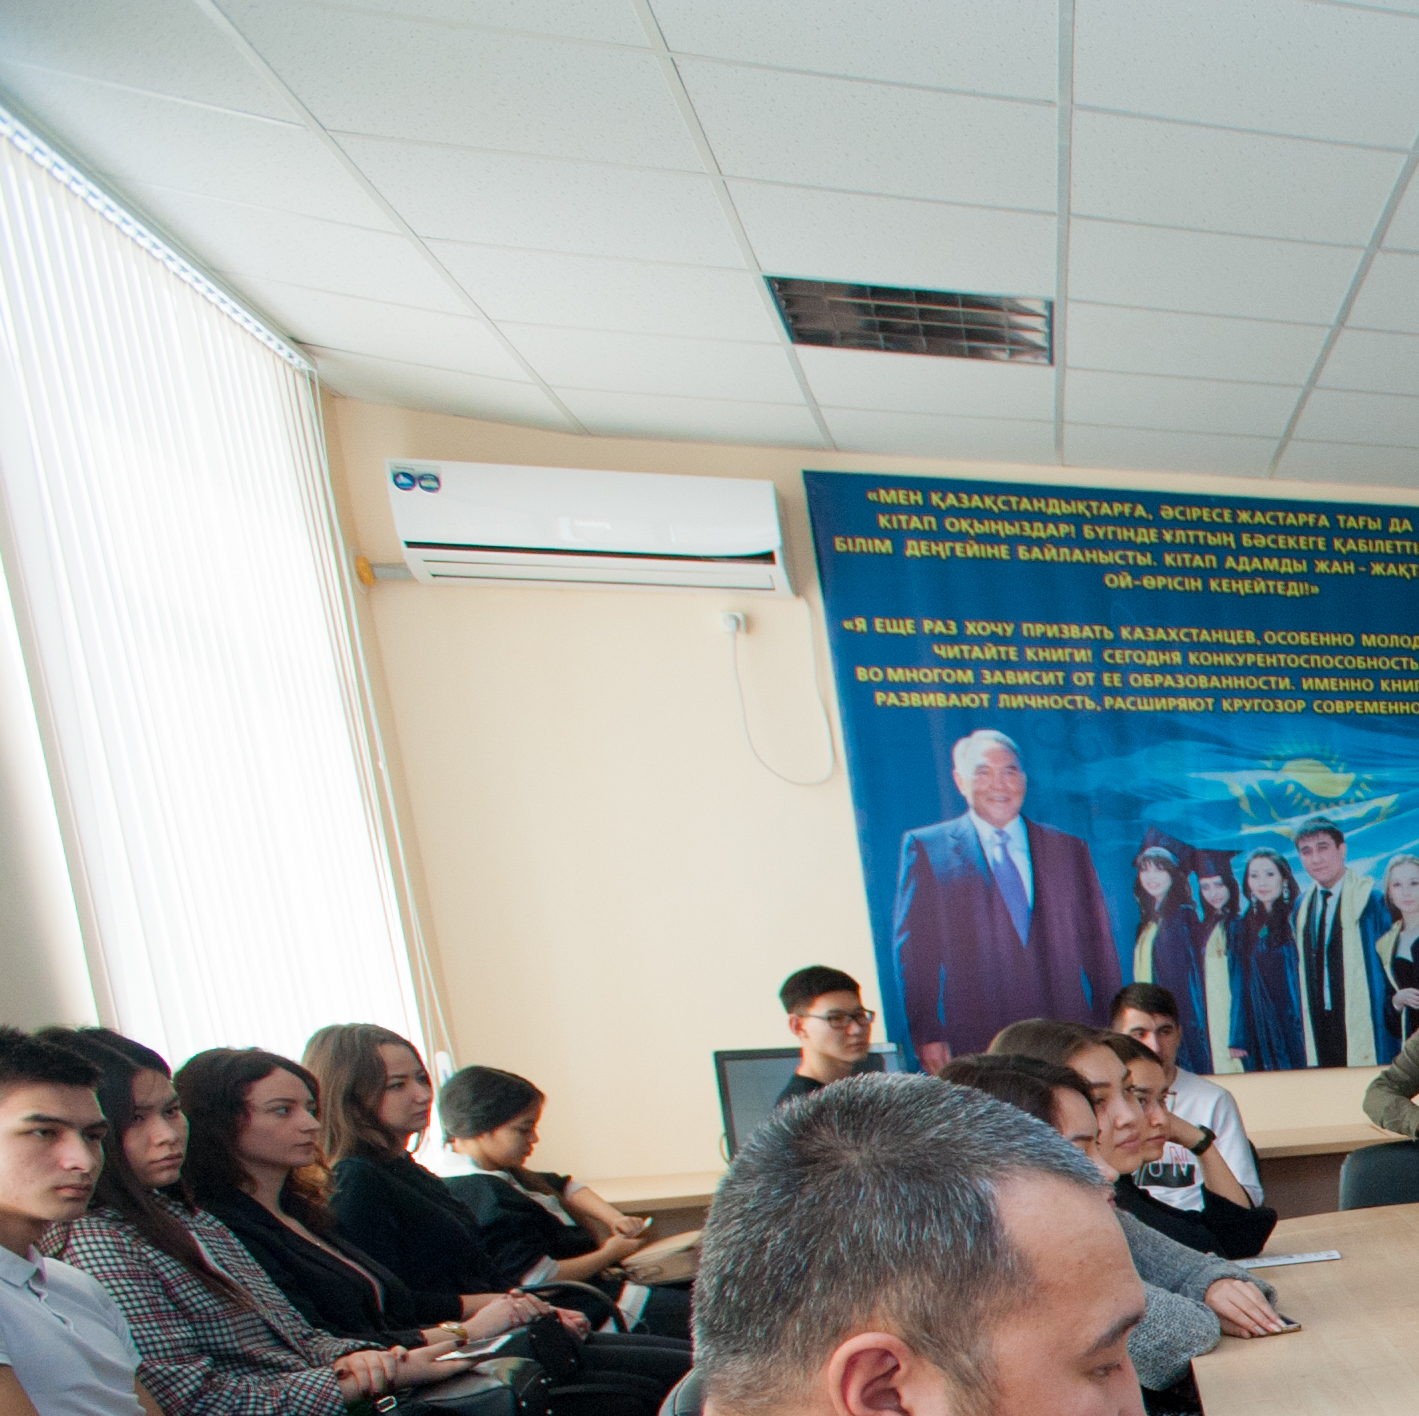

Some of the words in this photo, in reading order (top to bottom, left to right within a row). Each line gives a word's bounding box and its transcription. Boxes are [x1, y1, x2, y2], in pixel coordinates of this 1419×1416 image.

[867, 487, 923, 506] «МЕН
[1159, 504, 1233, 524] ӘСІРЕСЕ
[1237, 509, 1330, 528] ЖАСТАРҒА
[1337, 513, 1382, 531] ТАҒЫ
[1388, 517, 1413, 534] ДА
[877, 513, 937, 531] КІТАП
[944, 516, 1076, 543] ОҚЫҢЫЗДАР!
[1083, 523, 1159, 545] БҮГІНДЕ
[1162, 528, 1236, 550] ҰЛТТЫҢ
[1242, 531, 1327, 551] БӘСЕКЕГЕ
[834, 535, 893, 554] БІЛІМ
[905, 538, 1011, 561] ДЕҢГЕЙІНЕ
[1017, 542, 1158, 570] БАЙЛАНЫСТЫ.
[1163, 552, 1217, 569] КІТАП
[1224, 555, 1307, 577] АДАМДЫ
[1315, 554, 1355, 575] ЖАН
[1104, 570, 1202, 592] ОЙ-ӨРІСІН
[874, 617, 916, 636] ЕЩЕ
[922, 618, 958, 635] РАЗ
[964, 620, 1015, 637] ХОЧУ
[1022, 622, 1114, 641] ПРИЗВАТЬ
[1120, 626, 1262, 646] КАЗАХСТАНЦЕВ,
[1264, 630, 1355, 647] ОСОБЕННО
[933, 642, 1019, 661] ЧИТАЙТЕ
[1025, 646, 1093, 663] КНИГИ!
[1102, 648, 1182, 667] СЕГОДНЯ
[1188, 651, 1419, 671] КОНКУРЕНТОСПОСОБНОСТЬ
[855, 666, 884, 682] ВО
[887, 667, 975, 684] МНОГОМ
[980, 669, 1065, 686] ЗАВИСИТ
[1072, 671, 1096, 686] ОТ
[1102, 672, 1123, 688] ЕЕ
[1128, 673, 1296, 690] ОБРАЗОВАННОСТИ.
[1301, 676, 1375, 692] ИМЕННО
[874, 691, 990, 708] РАЗВИВАЮТ
[998, 693, 1102, 711] ЛИЧНОСТЬ,
[1104, 695, 1215, 712] РАСШИРЯЮТ
[1221, 698, 1306, 713] КРУГОЗОР
